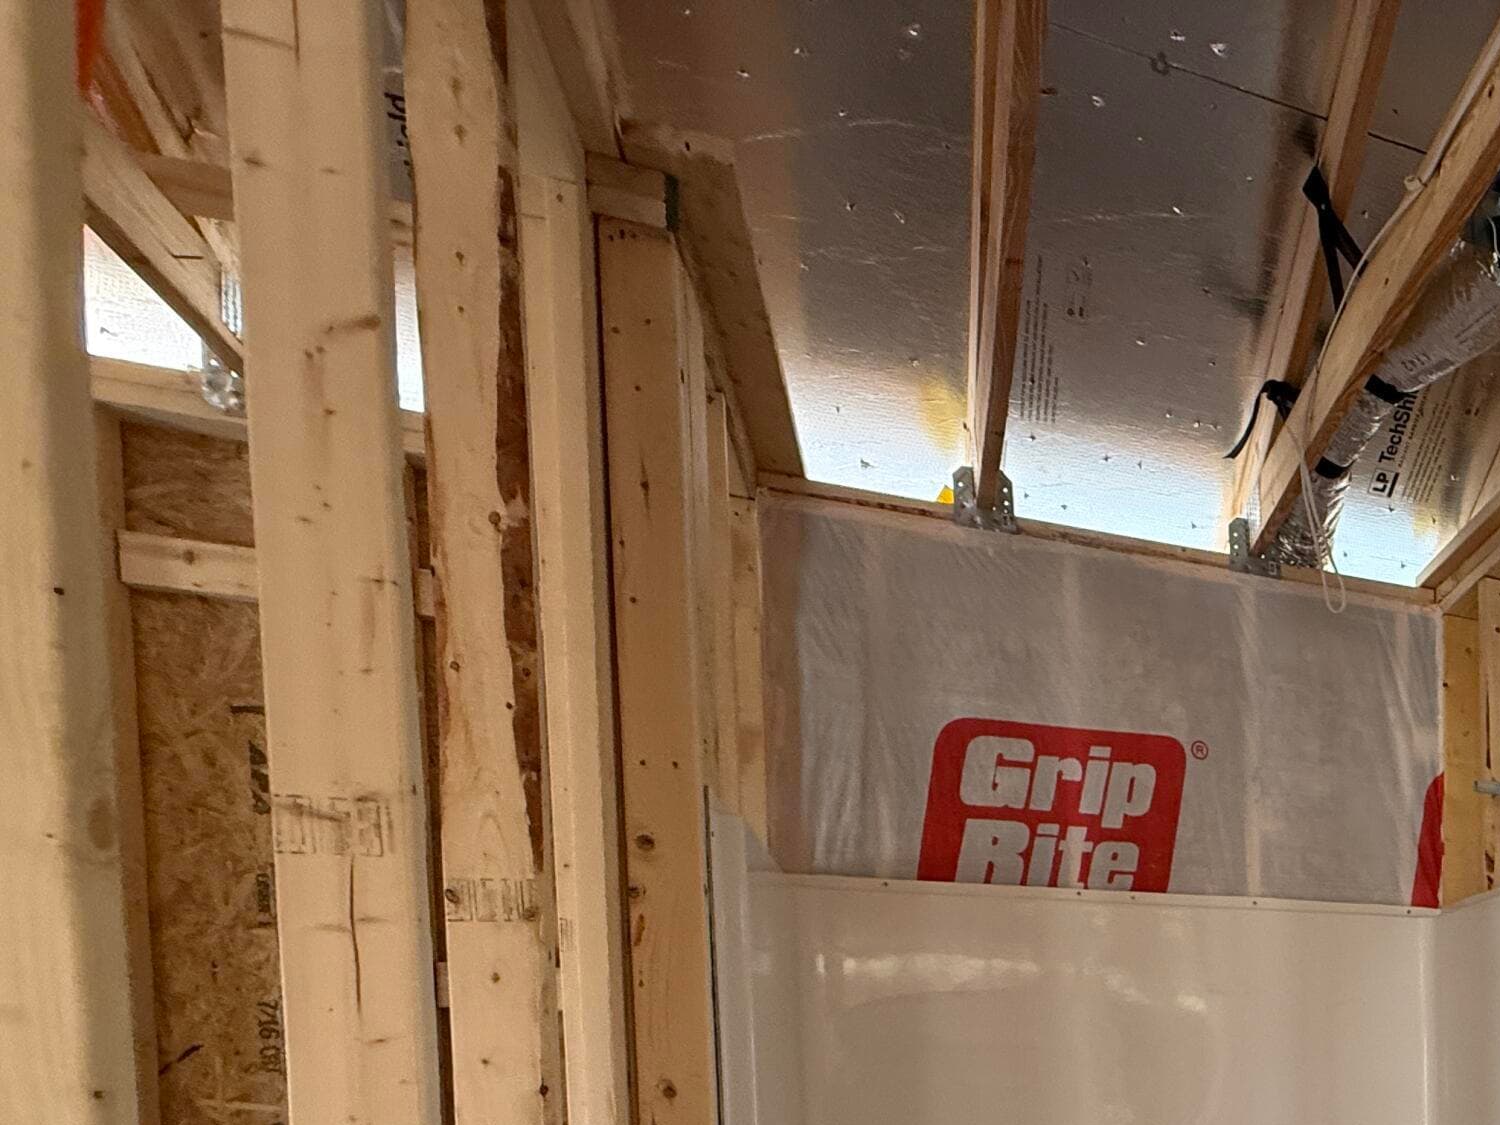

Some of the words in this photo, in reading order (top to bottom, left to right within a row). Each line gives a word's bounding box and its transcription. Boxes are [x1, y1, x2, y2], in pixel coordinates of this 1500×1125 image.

[1372, 472, 1389, 493] LP
[959, 735, 1158, 827] Grip
[955, 819, 1141, 893] Rite
